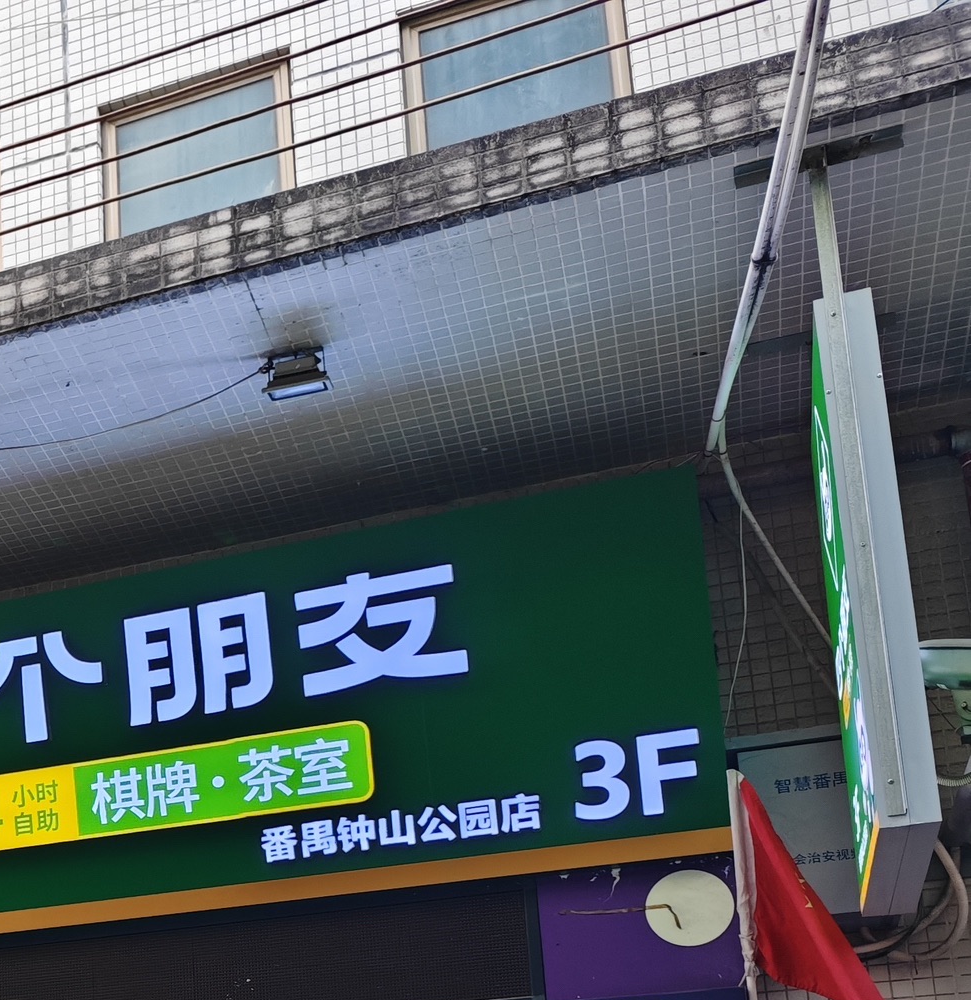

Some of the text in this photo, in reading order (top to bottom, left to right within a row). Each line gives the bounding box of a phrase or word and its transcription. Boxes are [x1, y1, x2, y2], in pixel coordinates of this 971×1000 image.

[10, 778, 60, 808] 小时
[574, 728, 701, 823] 3F
[12, 808, 60, 839] 自助
[260, 794, 541, 865] 番禺钟山公园店
